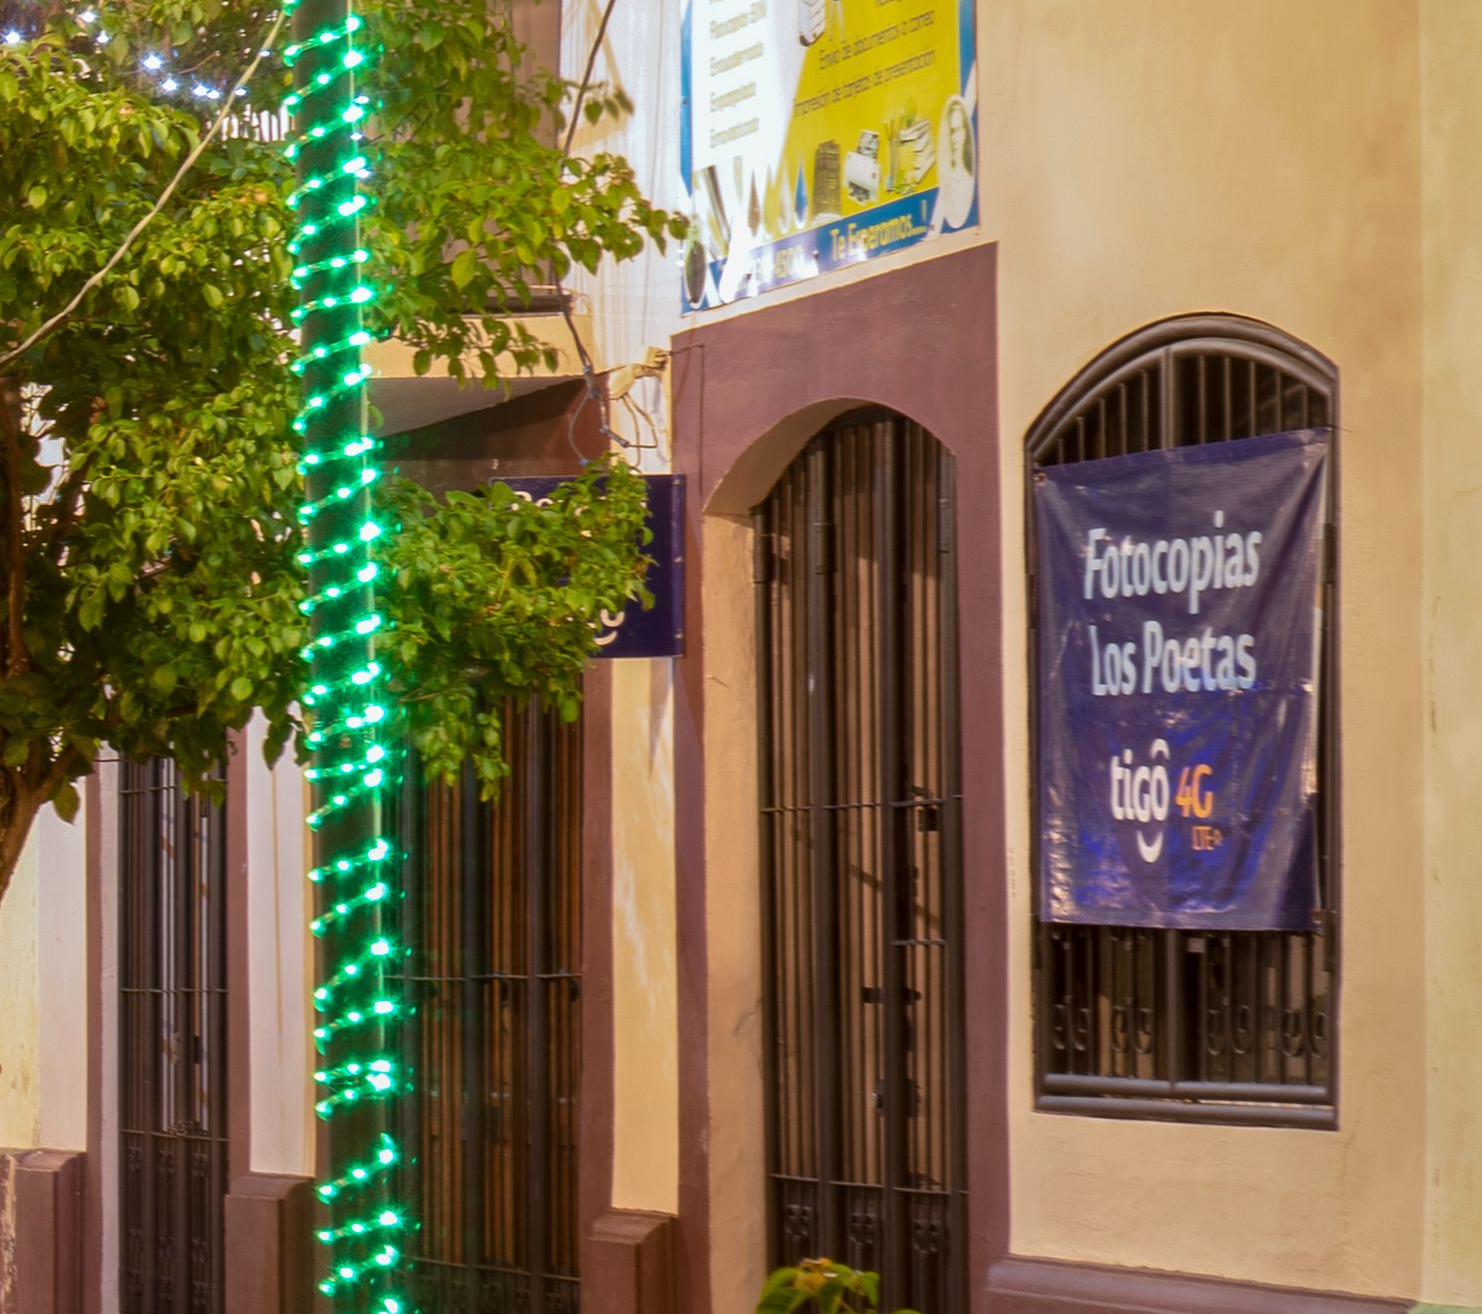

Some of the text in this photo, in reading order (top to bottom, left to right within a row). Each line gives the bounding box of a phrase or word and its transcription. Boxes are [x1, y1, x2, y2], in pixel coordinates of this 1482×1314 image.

[831, 227, 846, 262] Te
[1083, 510, 1263, 614] Fotocopias
[1089, 619, 1256, 696] Los Poetas
[1110, 738, 1214, 863] tigo 4G
